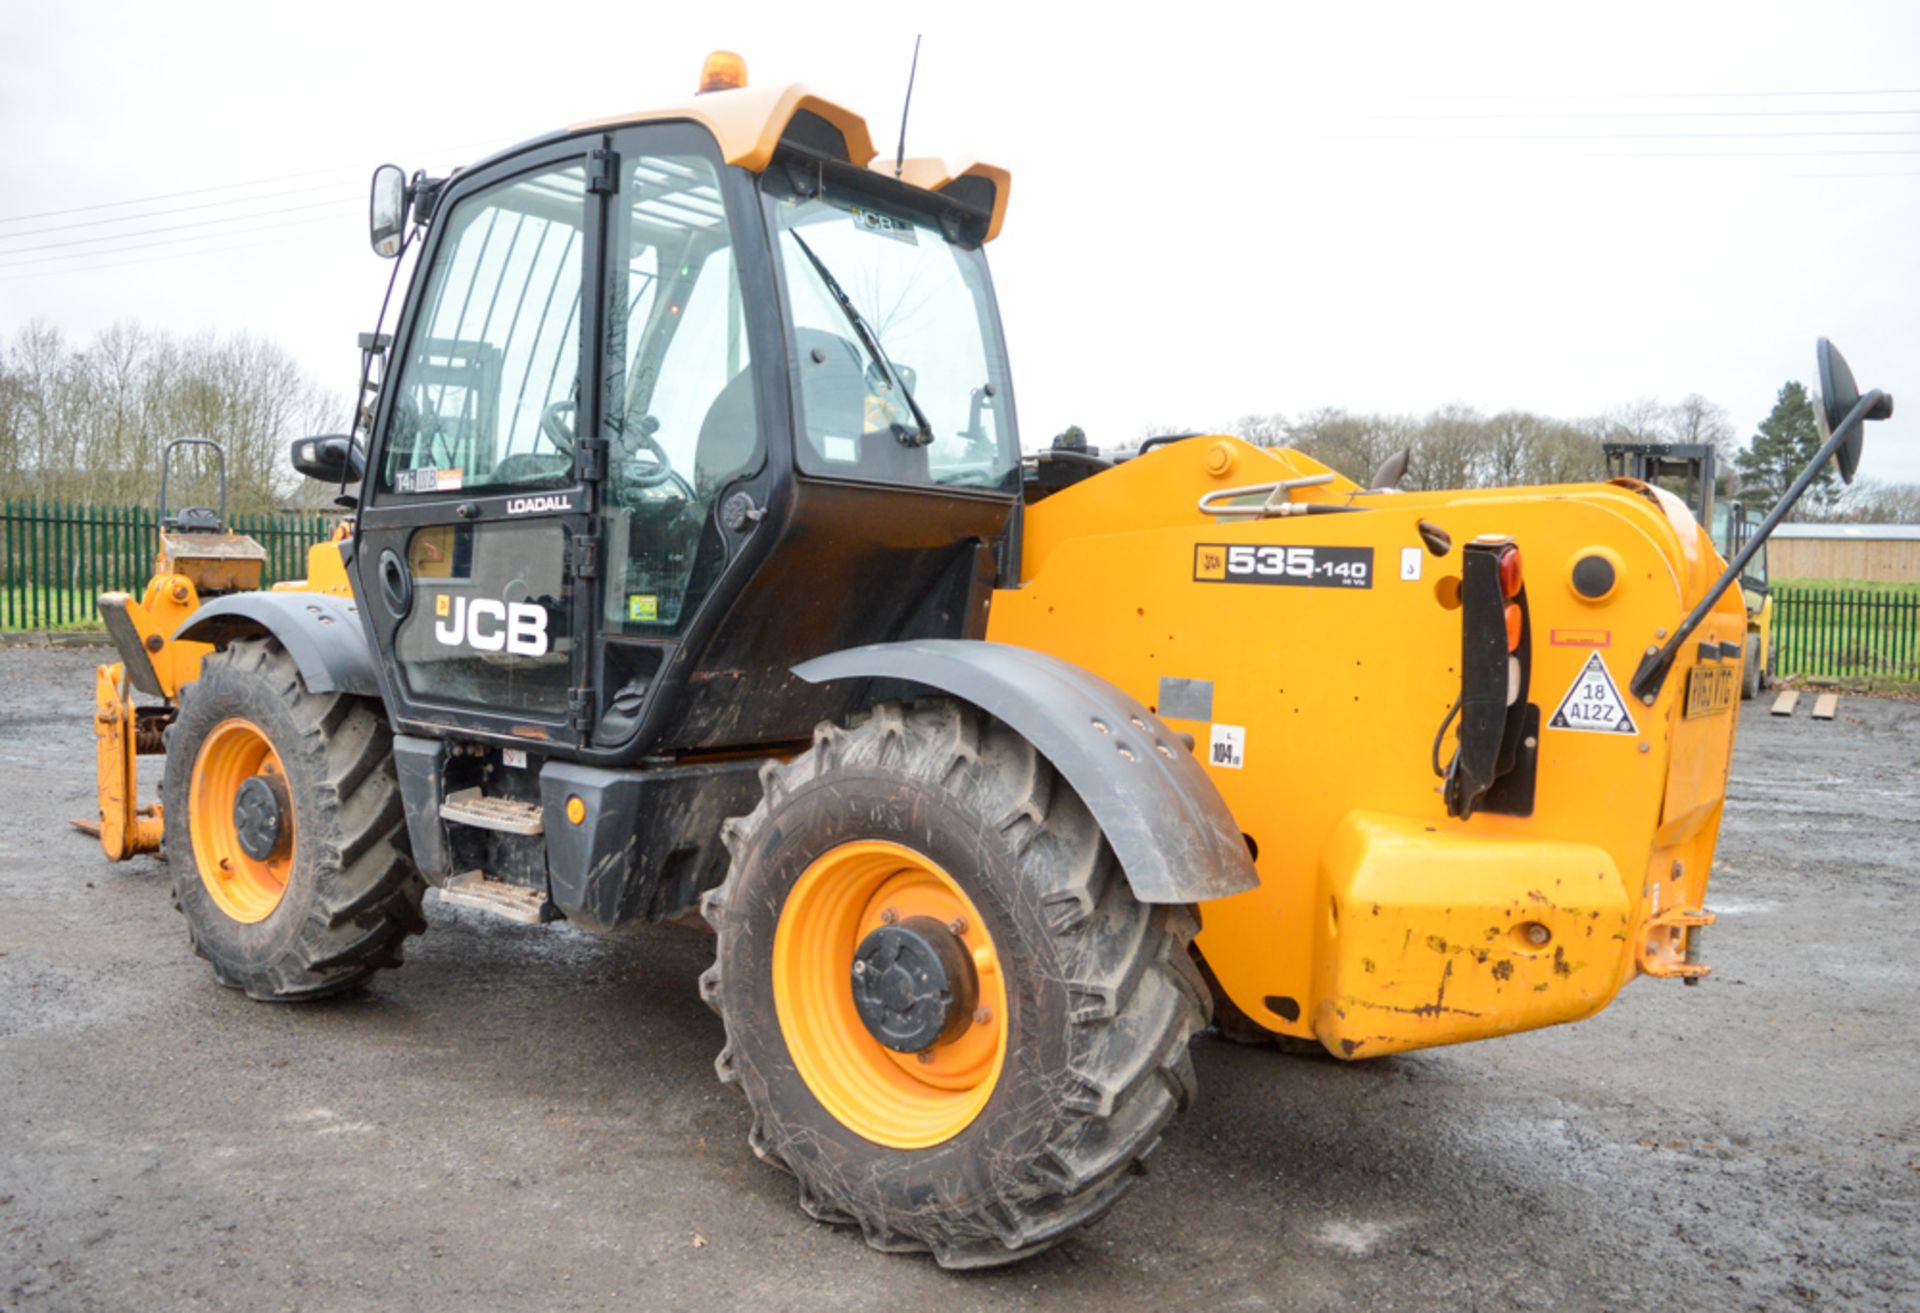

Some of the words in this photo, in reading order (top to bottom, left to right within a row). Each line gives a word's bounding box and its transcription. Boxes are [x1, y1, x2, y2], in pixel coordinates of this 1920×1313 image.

[507, 497, 571, 513] LOADALL
[1228, 547, 1366, 578] 535-140
[435, 596, 548, 657] JCB
[1583, 683, 1605, 701] 18
[1213, 742, 1232, 764] 104
